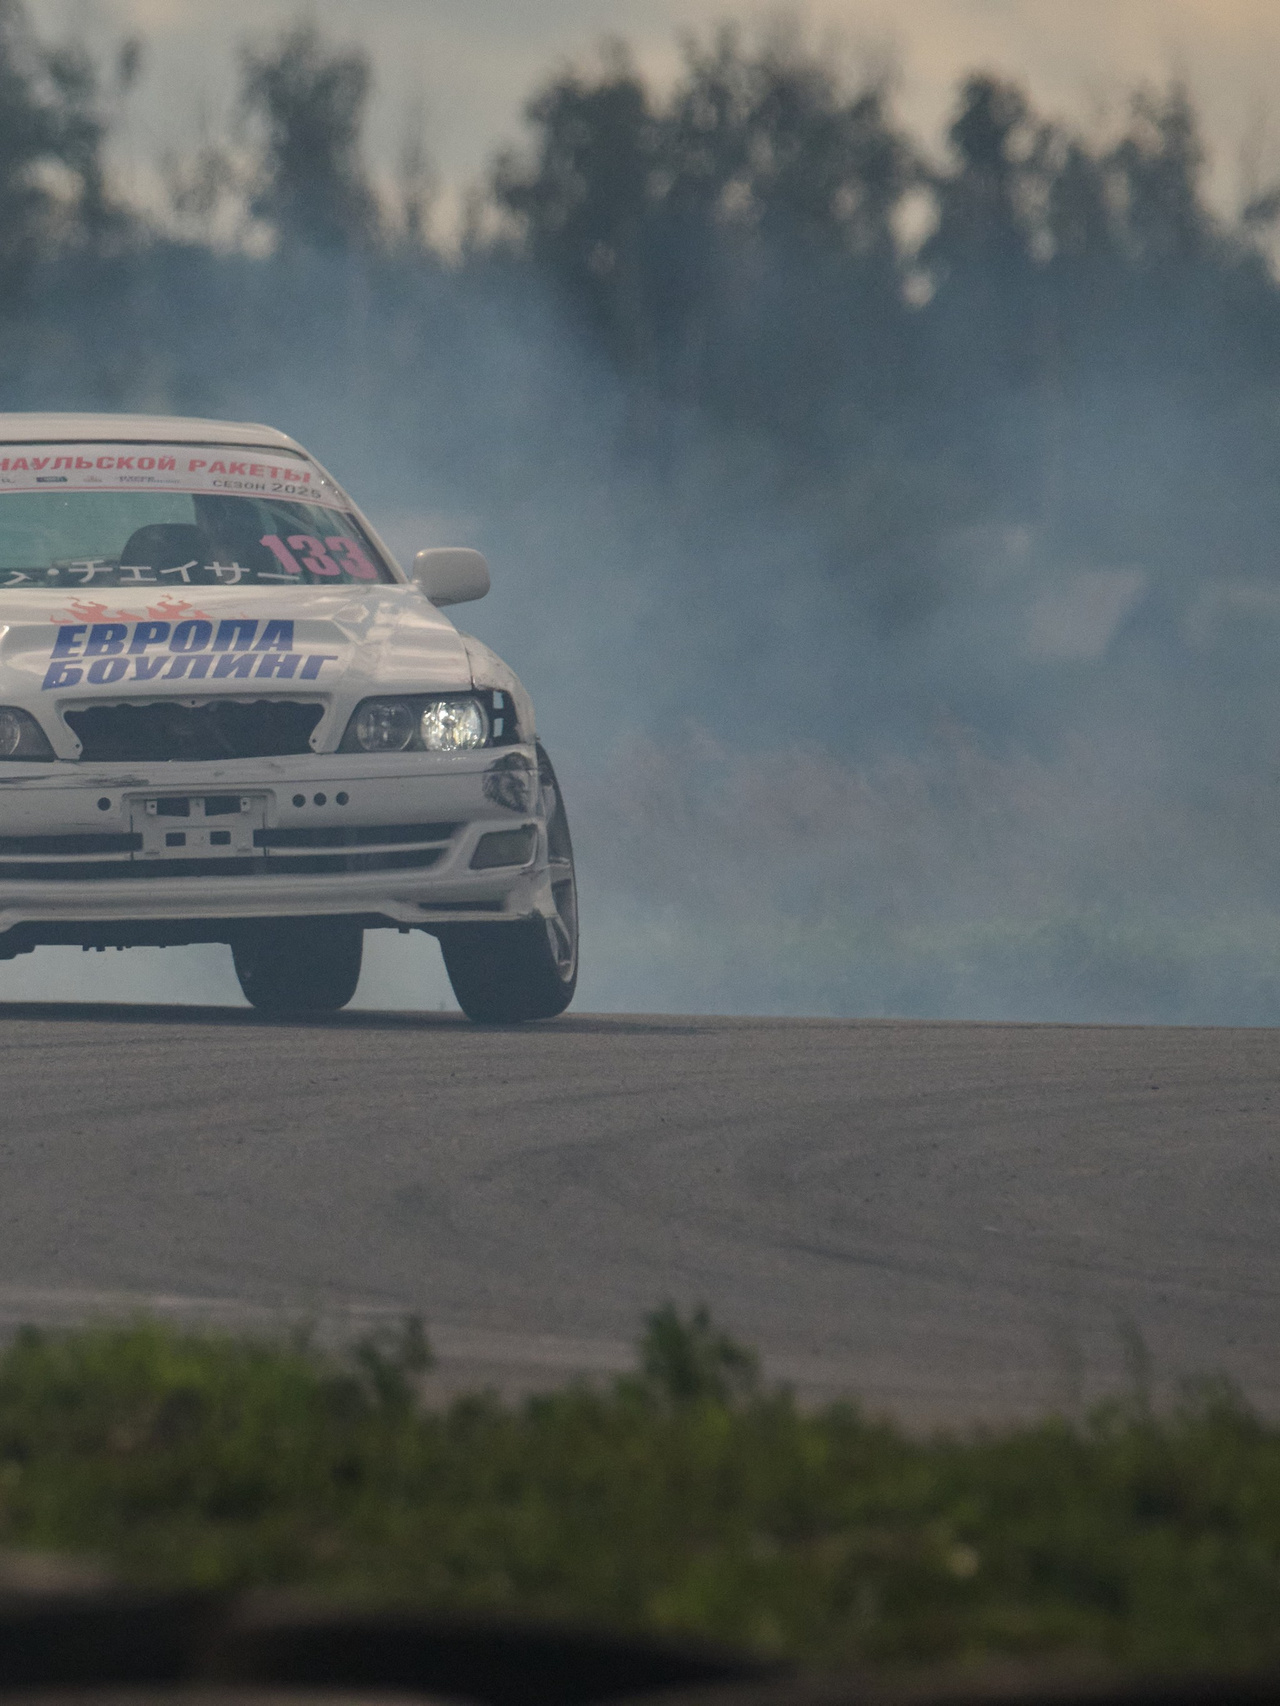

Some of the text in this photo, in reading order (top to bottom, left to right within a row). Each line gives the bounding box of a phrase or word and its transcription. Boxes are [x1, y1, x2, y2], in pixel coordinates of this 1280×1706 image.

[188, 459, 311, 484] РАКЕТЫ
[213, 479, 322, 499] СЕЗОН 2025
[260, 534, 378, 580] 133
[41, 619, 339, 692] ЕВРОПА БОУЛИНГ
